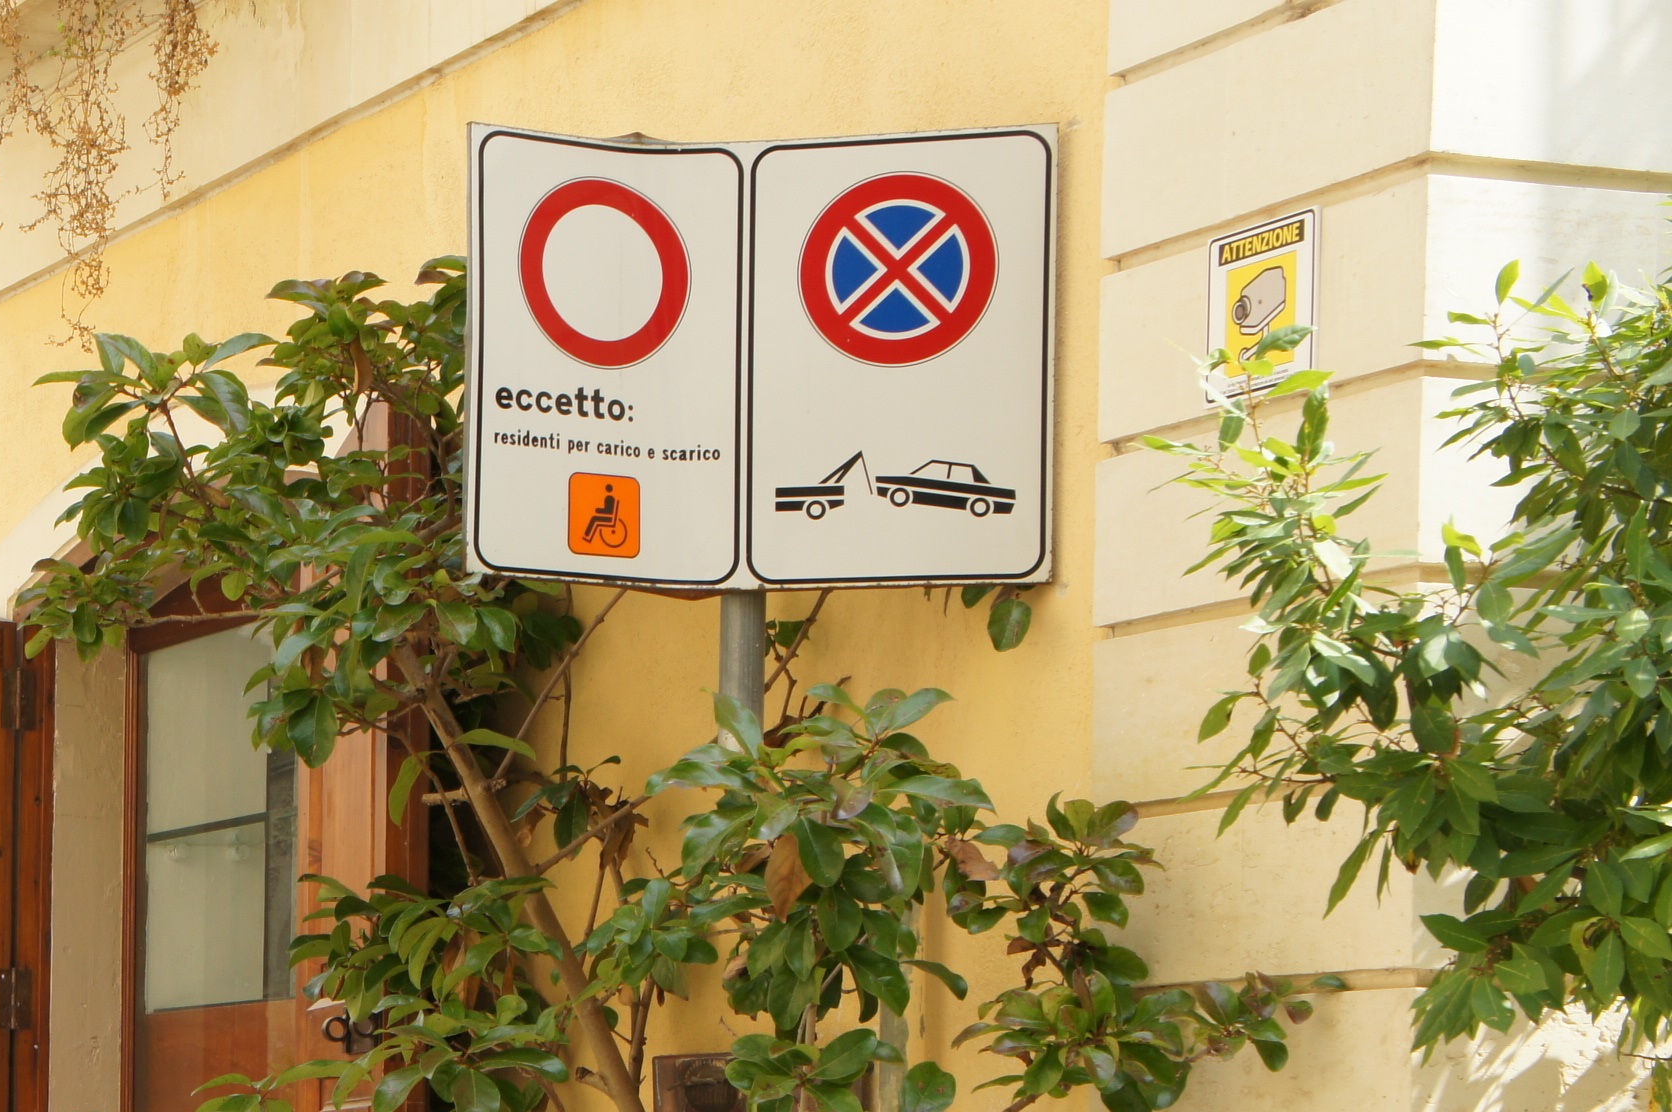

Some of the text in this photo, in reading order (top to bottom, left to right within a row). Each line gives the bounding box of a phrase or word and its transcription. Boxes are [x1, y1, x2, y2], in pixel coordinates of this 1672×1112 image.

[1221, 222, 1301, 264] ATTENZIONE
[495, 386, 634, 423] eccetto:
[494, 429, 721, 462] residenti per carico e scarico
